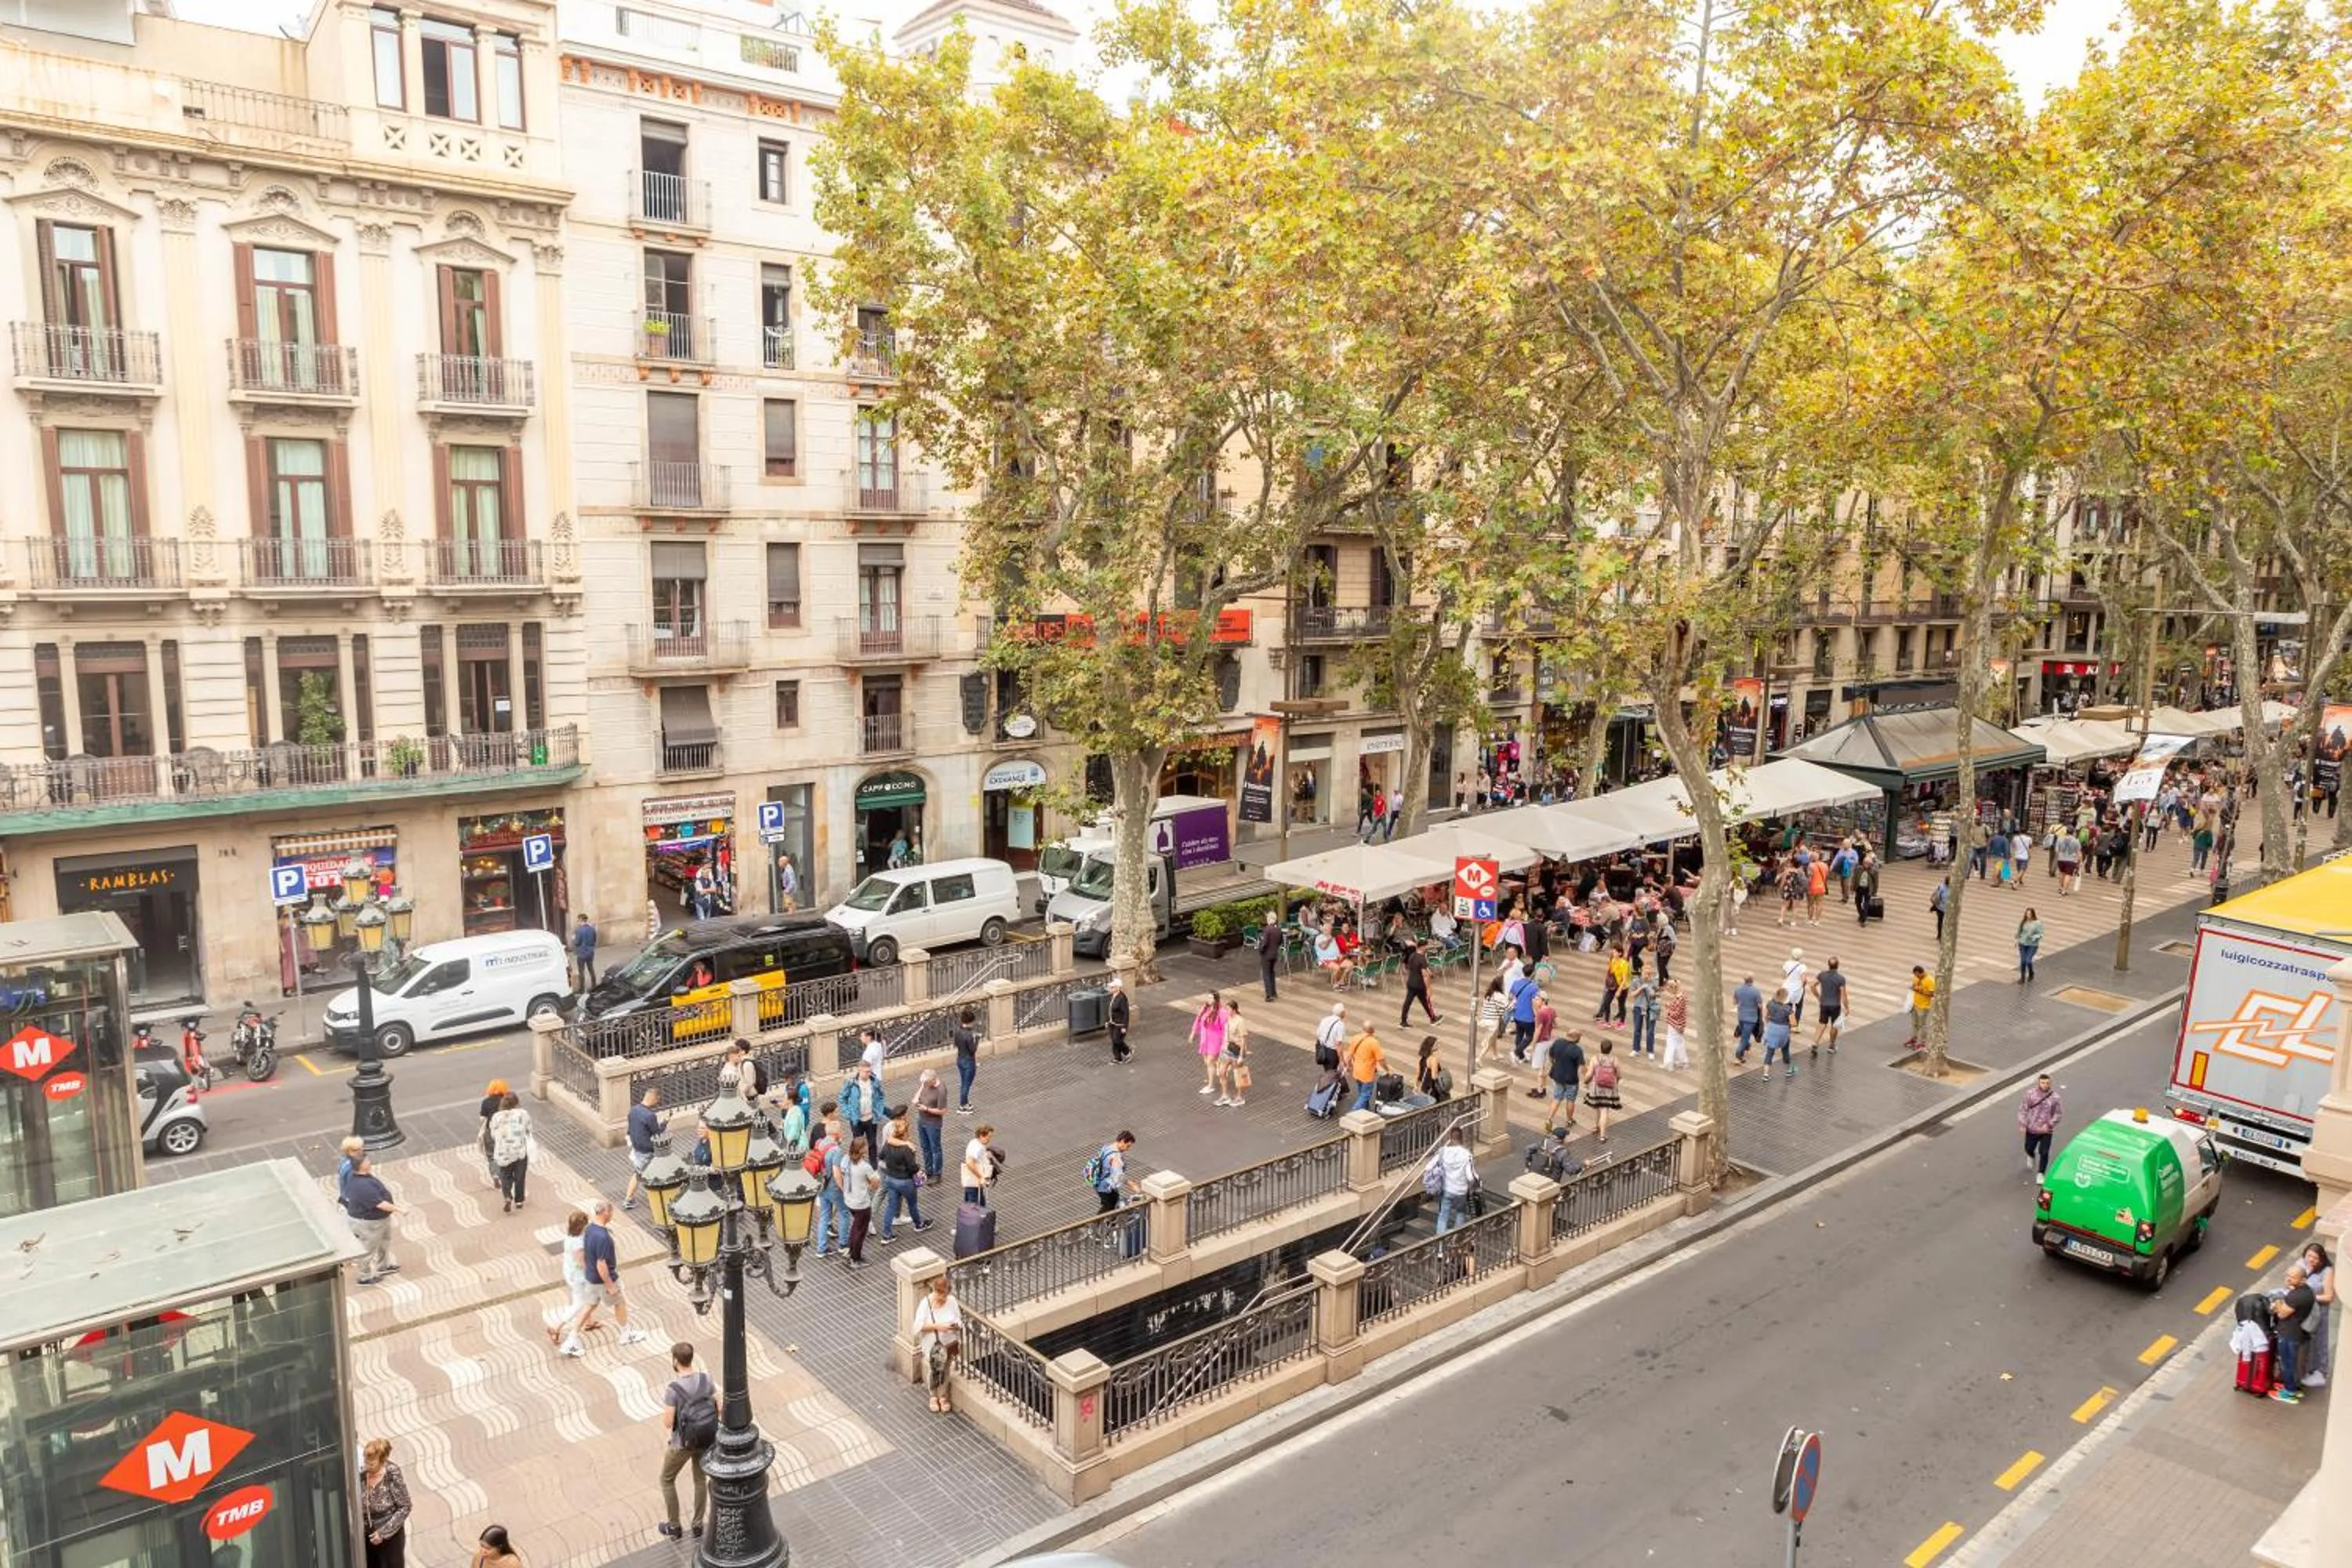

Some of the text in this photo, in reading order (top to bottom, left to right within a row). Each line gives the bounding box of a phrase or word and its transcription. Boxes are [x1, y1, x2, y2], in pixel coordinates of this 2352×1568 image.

[763, 806, 779, 828] P
[529, 840, 546, 863] P
[89, 869, 168, 891] RAMBLAS
[277, 869, 299, 896] P
[1468, 869, 1481, 884] M
[12, 1037, 53, 1069] M
[50, 1080, 82, 1094] TMB
[146, 1428, 212, 1490] M
[216, 1498, 264, 1527] TMB
